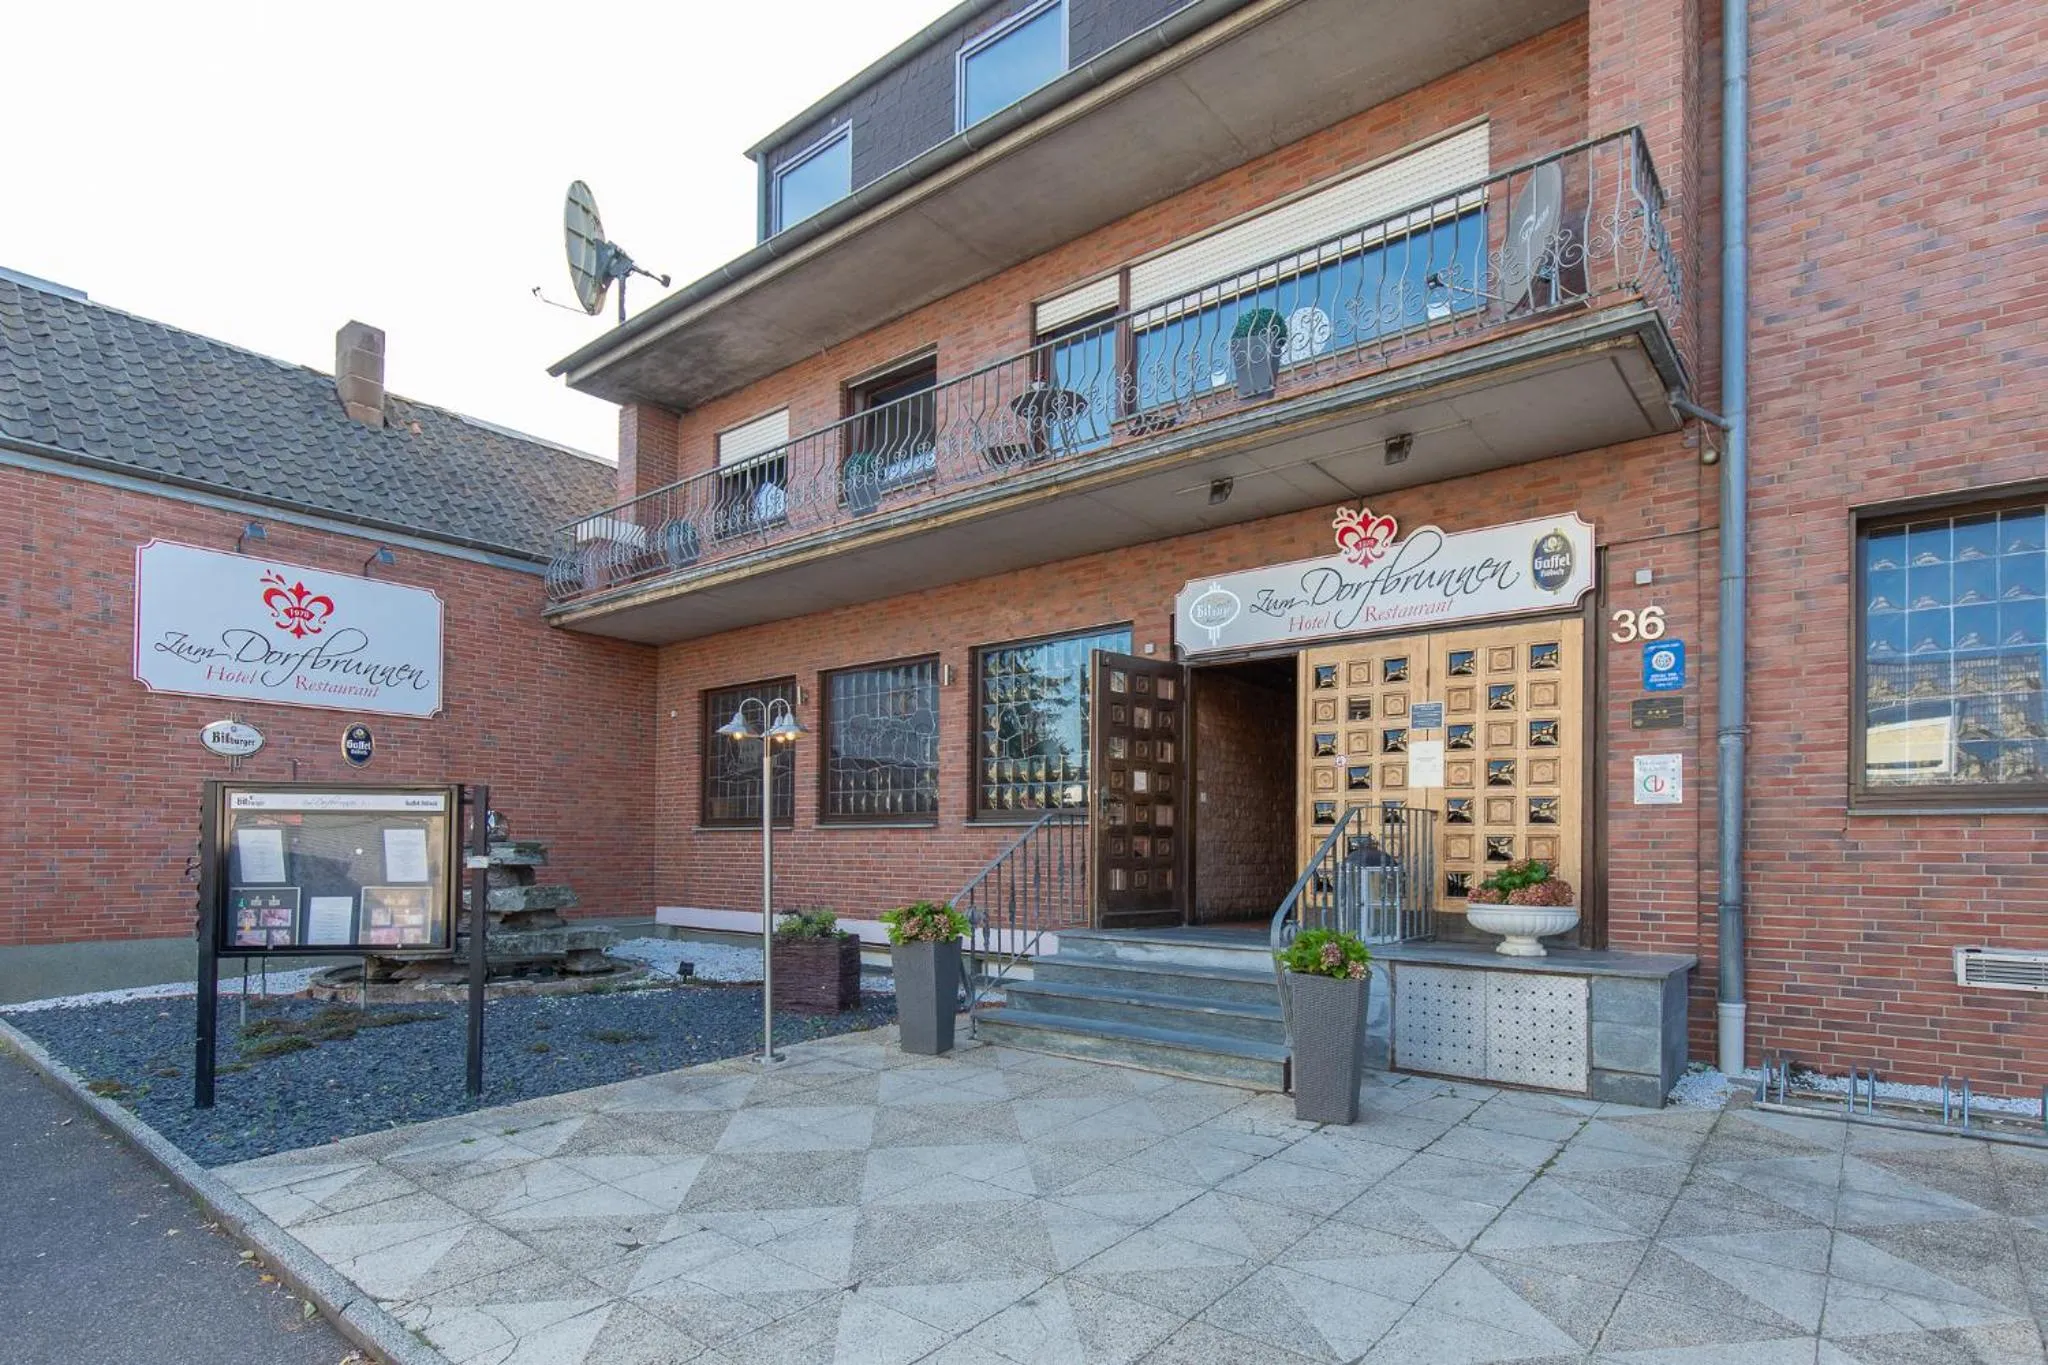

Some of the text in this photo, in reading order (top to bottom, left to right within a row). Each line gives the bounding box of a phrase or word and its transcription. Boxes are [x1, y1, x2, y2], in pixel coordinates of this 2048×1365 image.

[1534, 553, 1571, 570] Gaffel
[1249, 530, 1520, 630] Zum Dorfbrunnen
[1288, 599, 1454, 633] Hotel Restaurant
[1611, 605, 1666, 643] 36
[154, 627, 430, 690] Zum Dorfbrunnen
[206, 664, 380, 699] Hotel Restaurant
[211, 731, 255, 750] Bitburger
